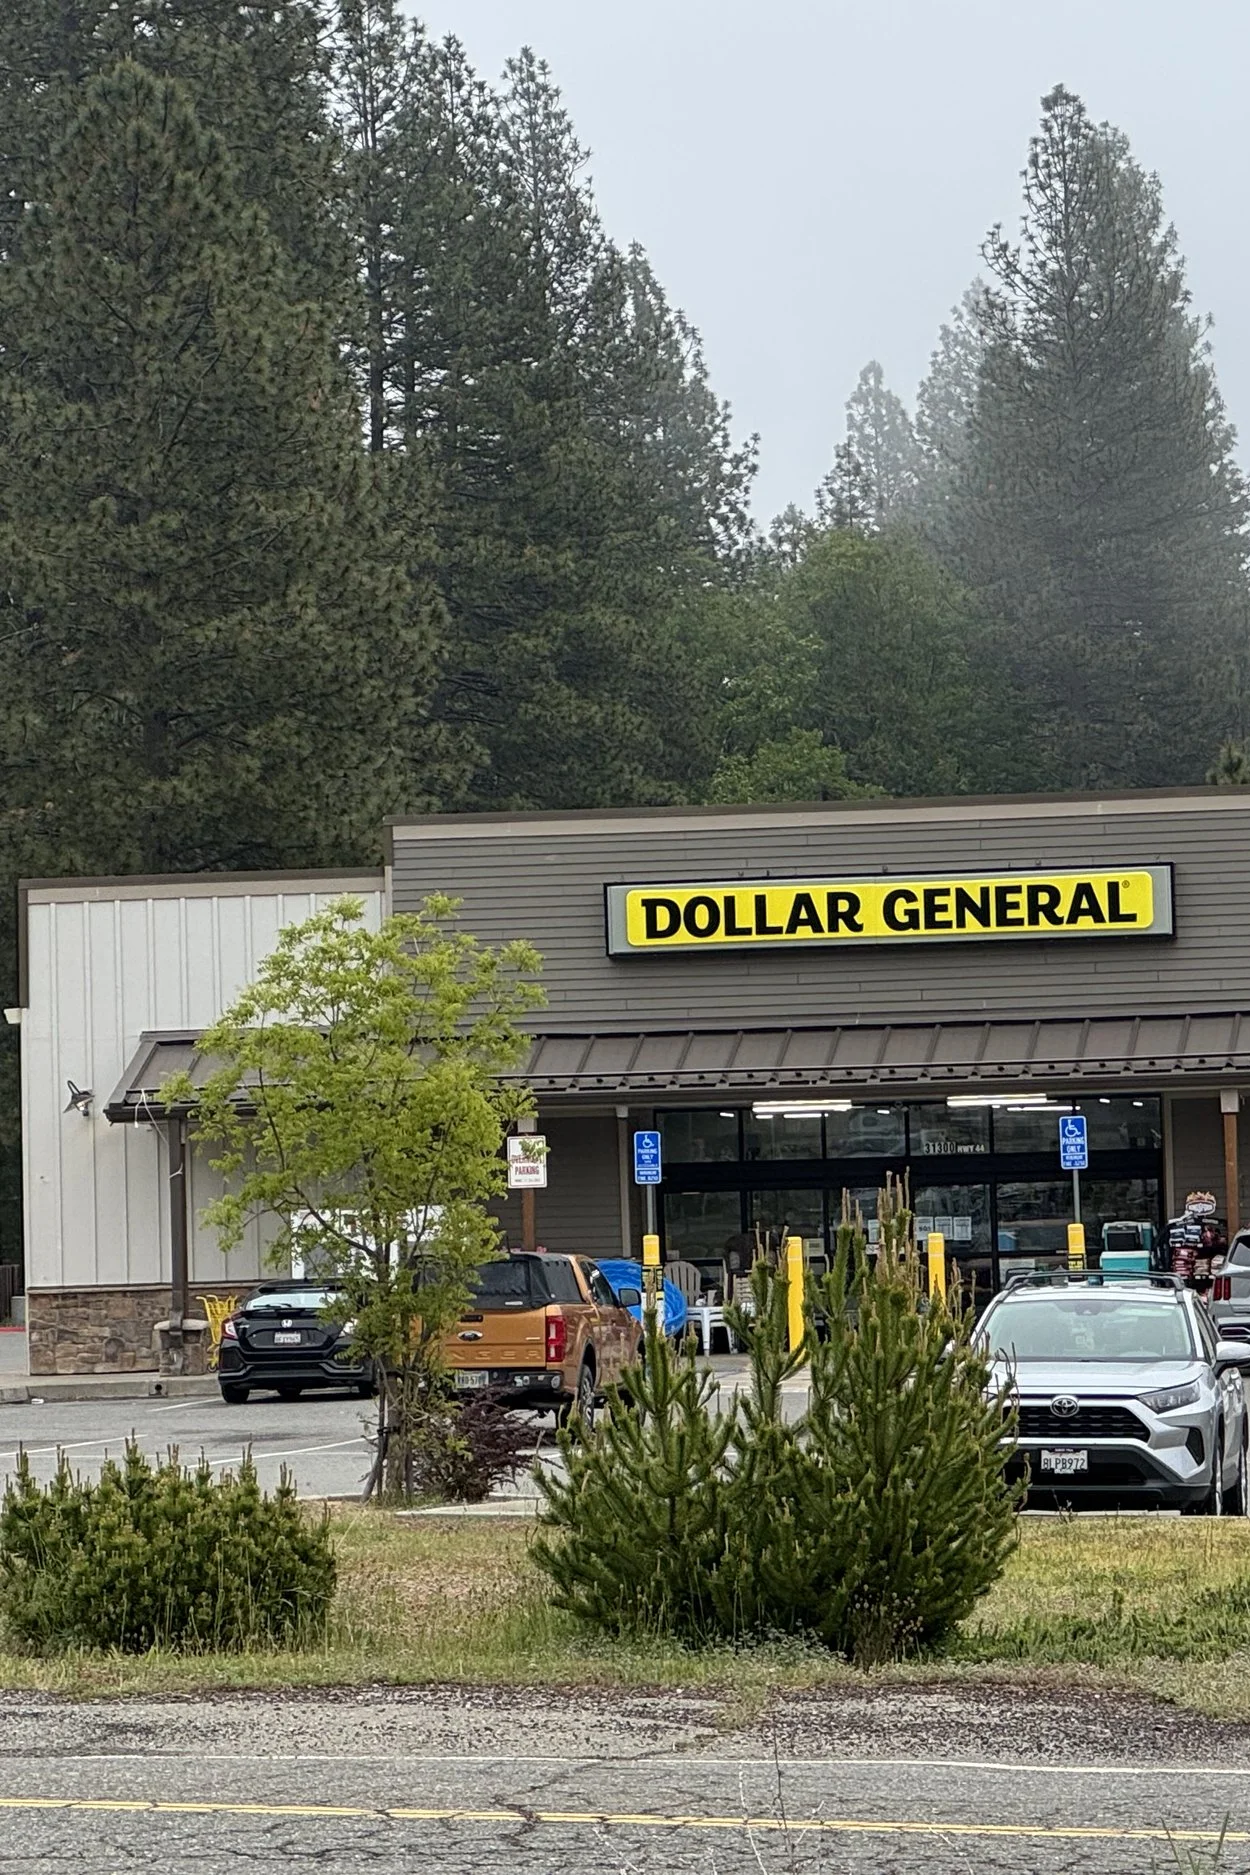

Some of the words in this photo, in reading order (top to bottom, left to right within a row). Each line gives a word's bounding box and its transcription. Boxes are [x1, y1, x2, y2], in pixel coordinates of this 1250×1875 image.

[641, 891, 865, 940] DOLLAR
[882, 881, 1138, 932] GENERAL
[1063, 1136, 1085, 1144] PARKING
[924, 1142, 955, 1154] 31300
[957, 1144, 975, 1153] HWY
[975, 1144, 986, 1152] 44
[1066, 1145, 1081, 1153] ONLY
[514, 1165, 540, 1175] PARKING
